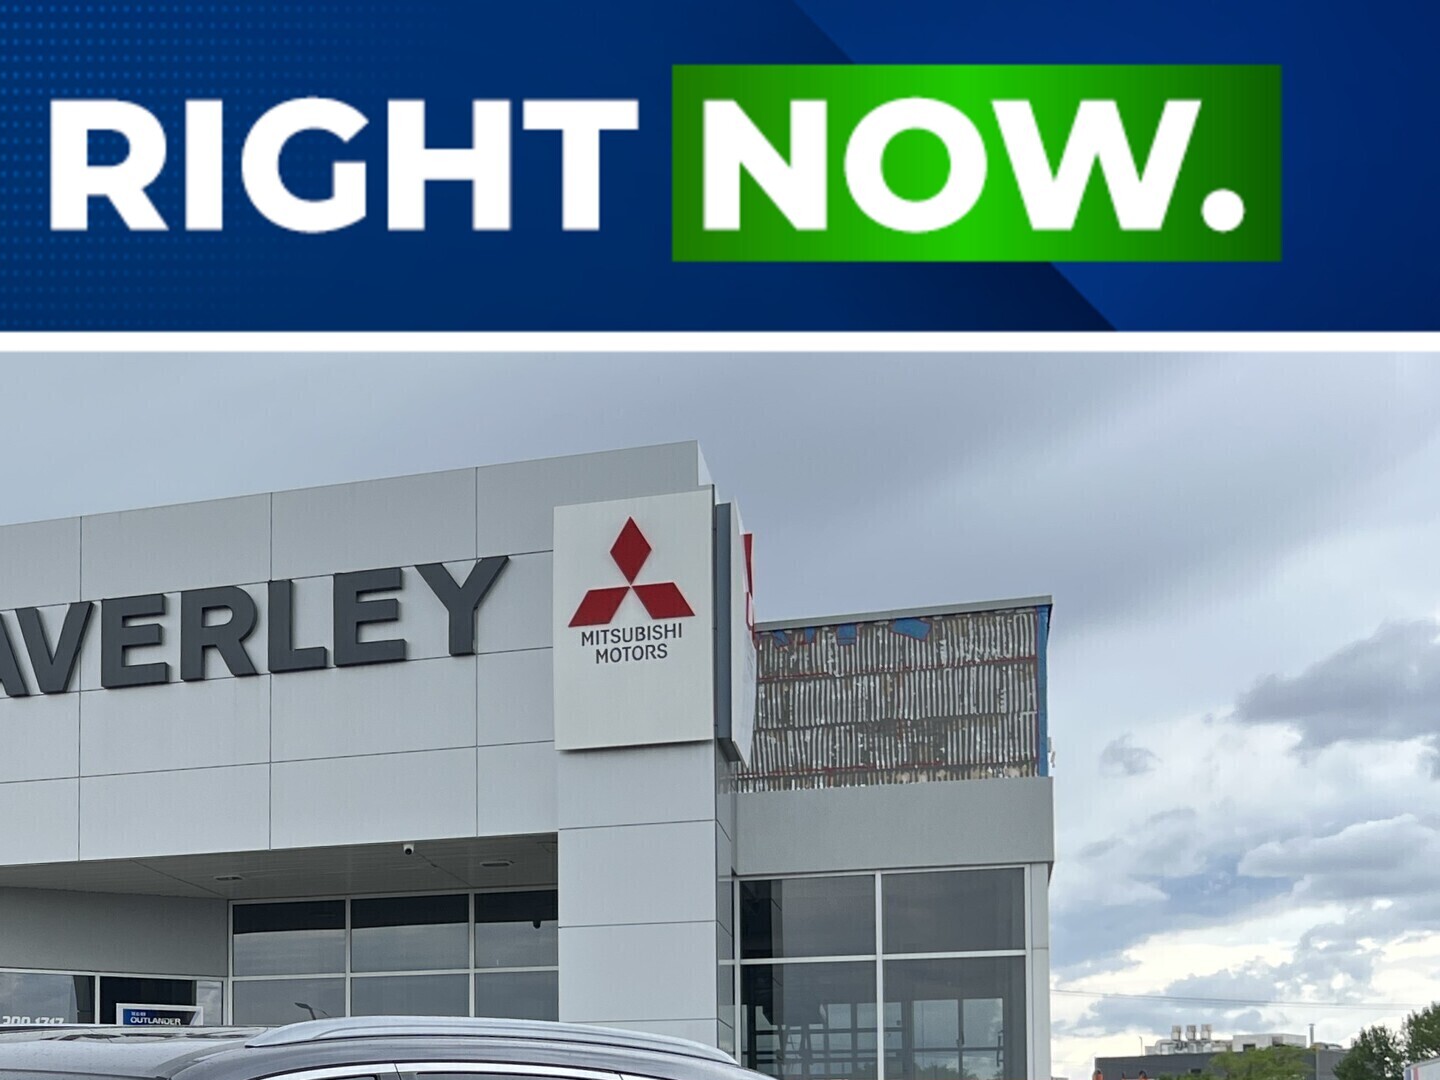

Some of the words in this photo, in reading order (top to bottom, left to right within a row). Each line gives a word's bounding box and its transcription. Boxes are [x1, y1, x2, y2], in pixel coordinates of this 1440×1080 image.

[581, 622, 682, 647] MITSUBISHI
[595, 643, 668, 664] MOTORS
[130, 1016, 181, 1025] OUTLANDER
